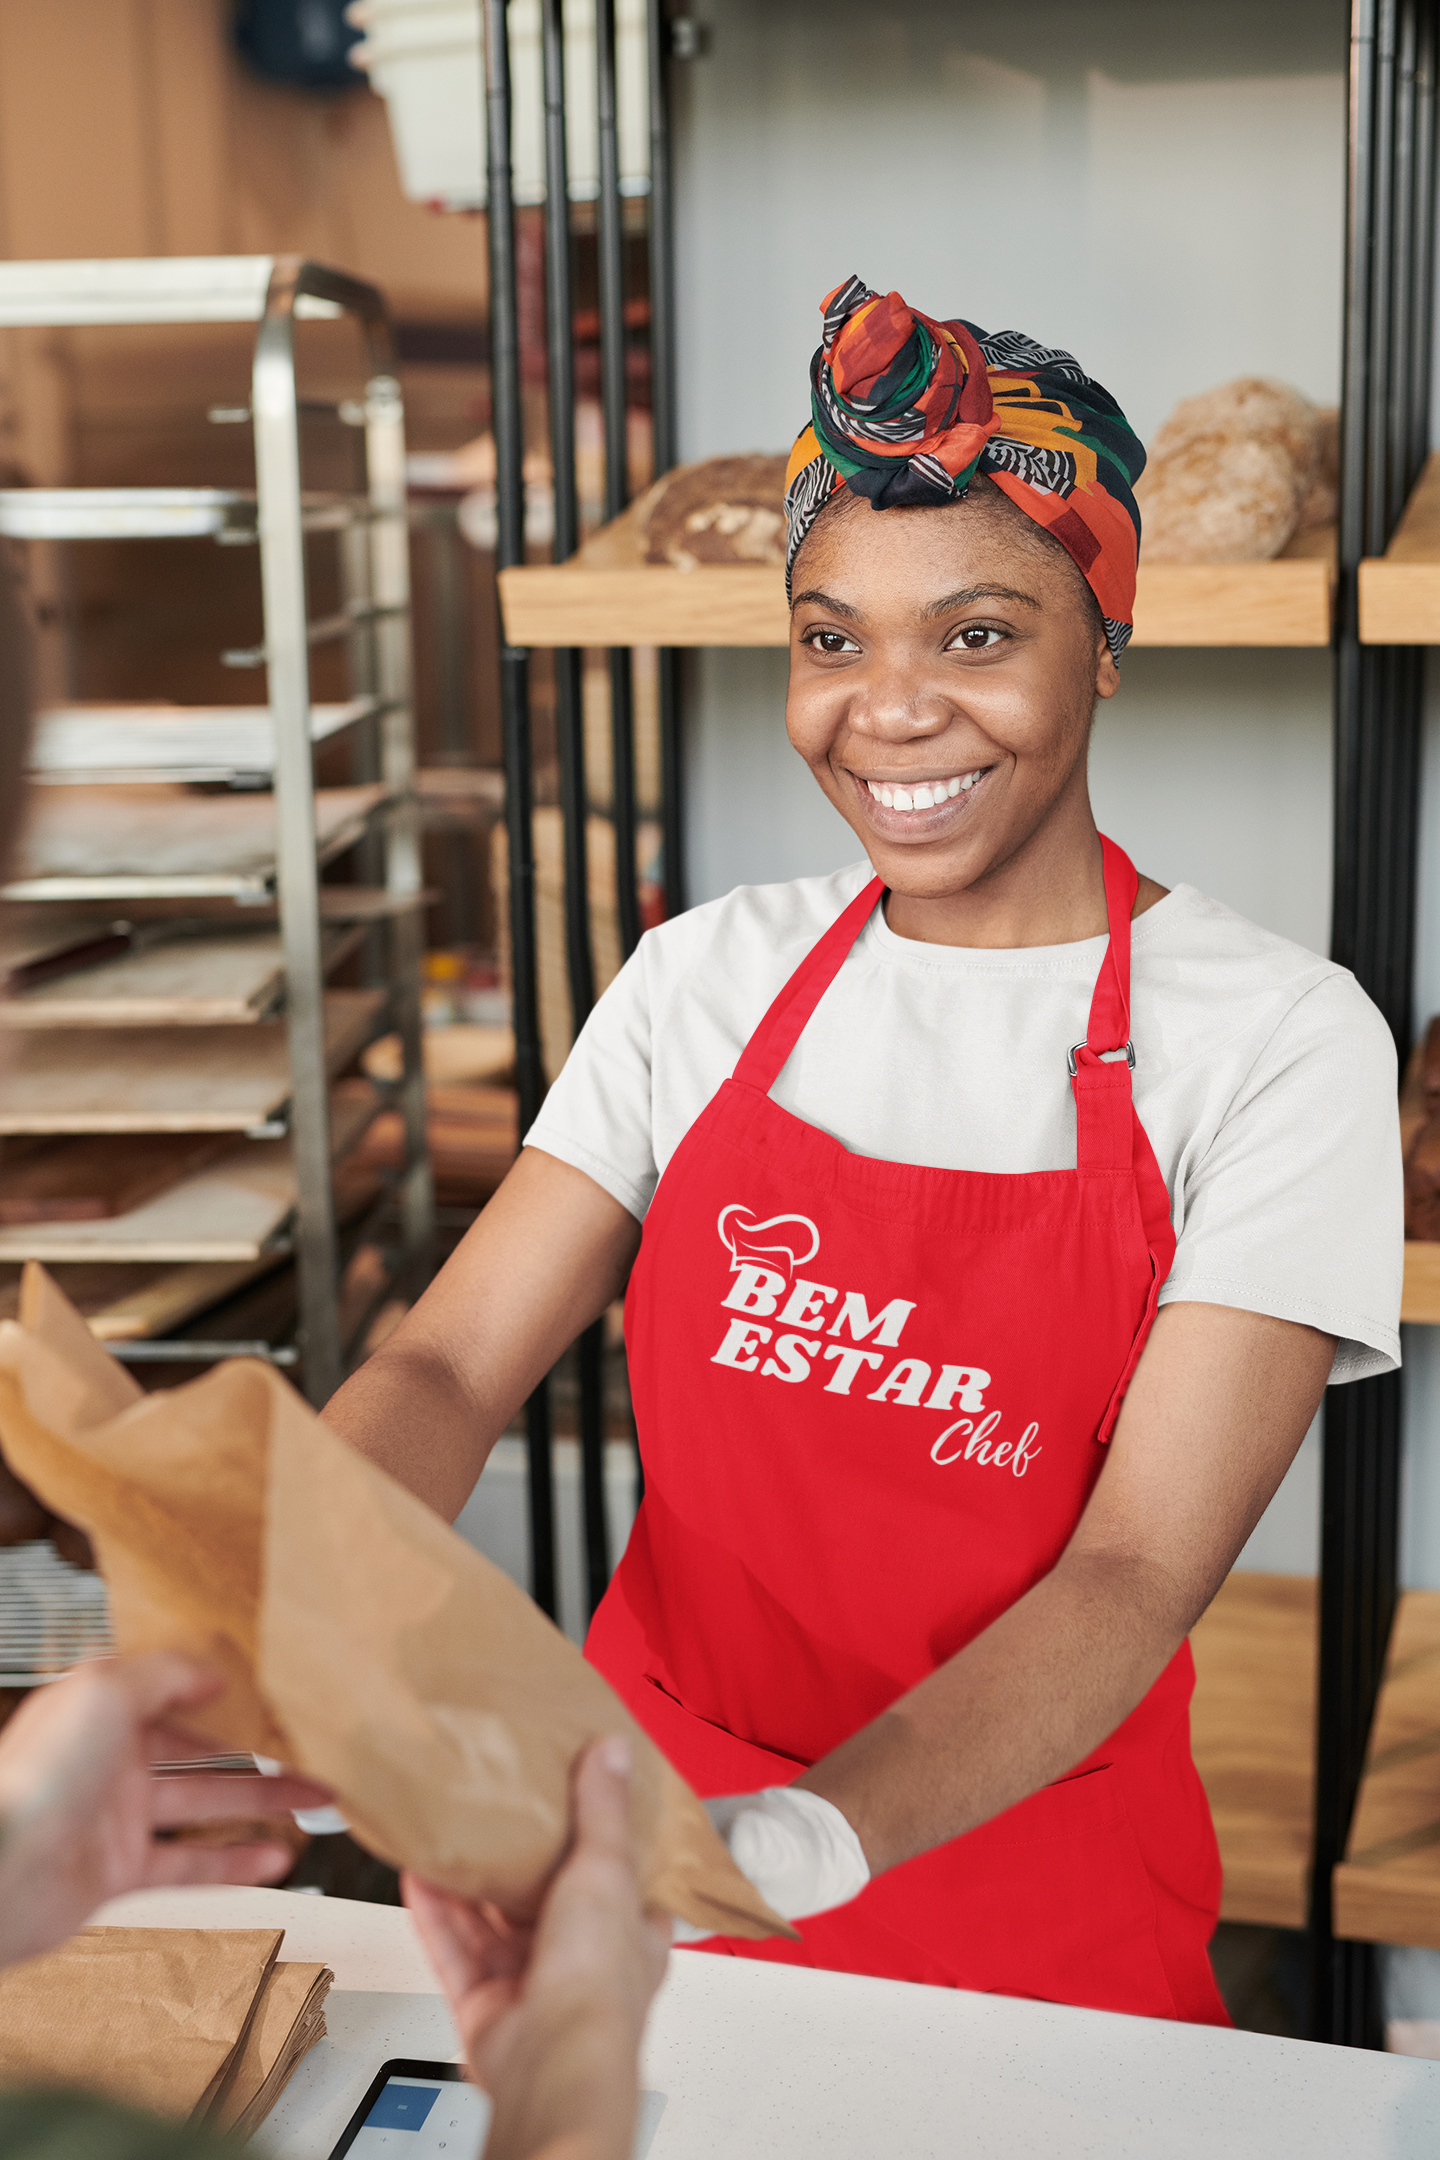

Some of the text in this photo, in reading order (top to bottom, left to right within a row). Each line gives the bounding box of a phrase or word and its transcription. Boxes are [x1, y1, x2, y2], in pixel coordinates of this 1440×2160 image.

[720, 1263, 917, 1347] BEM
[710, 1318, 992, 1413] ESTAR
[930, 1410, 1042, 1477] Chef
